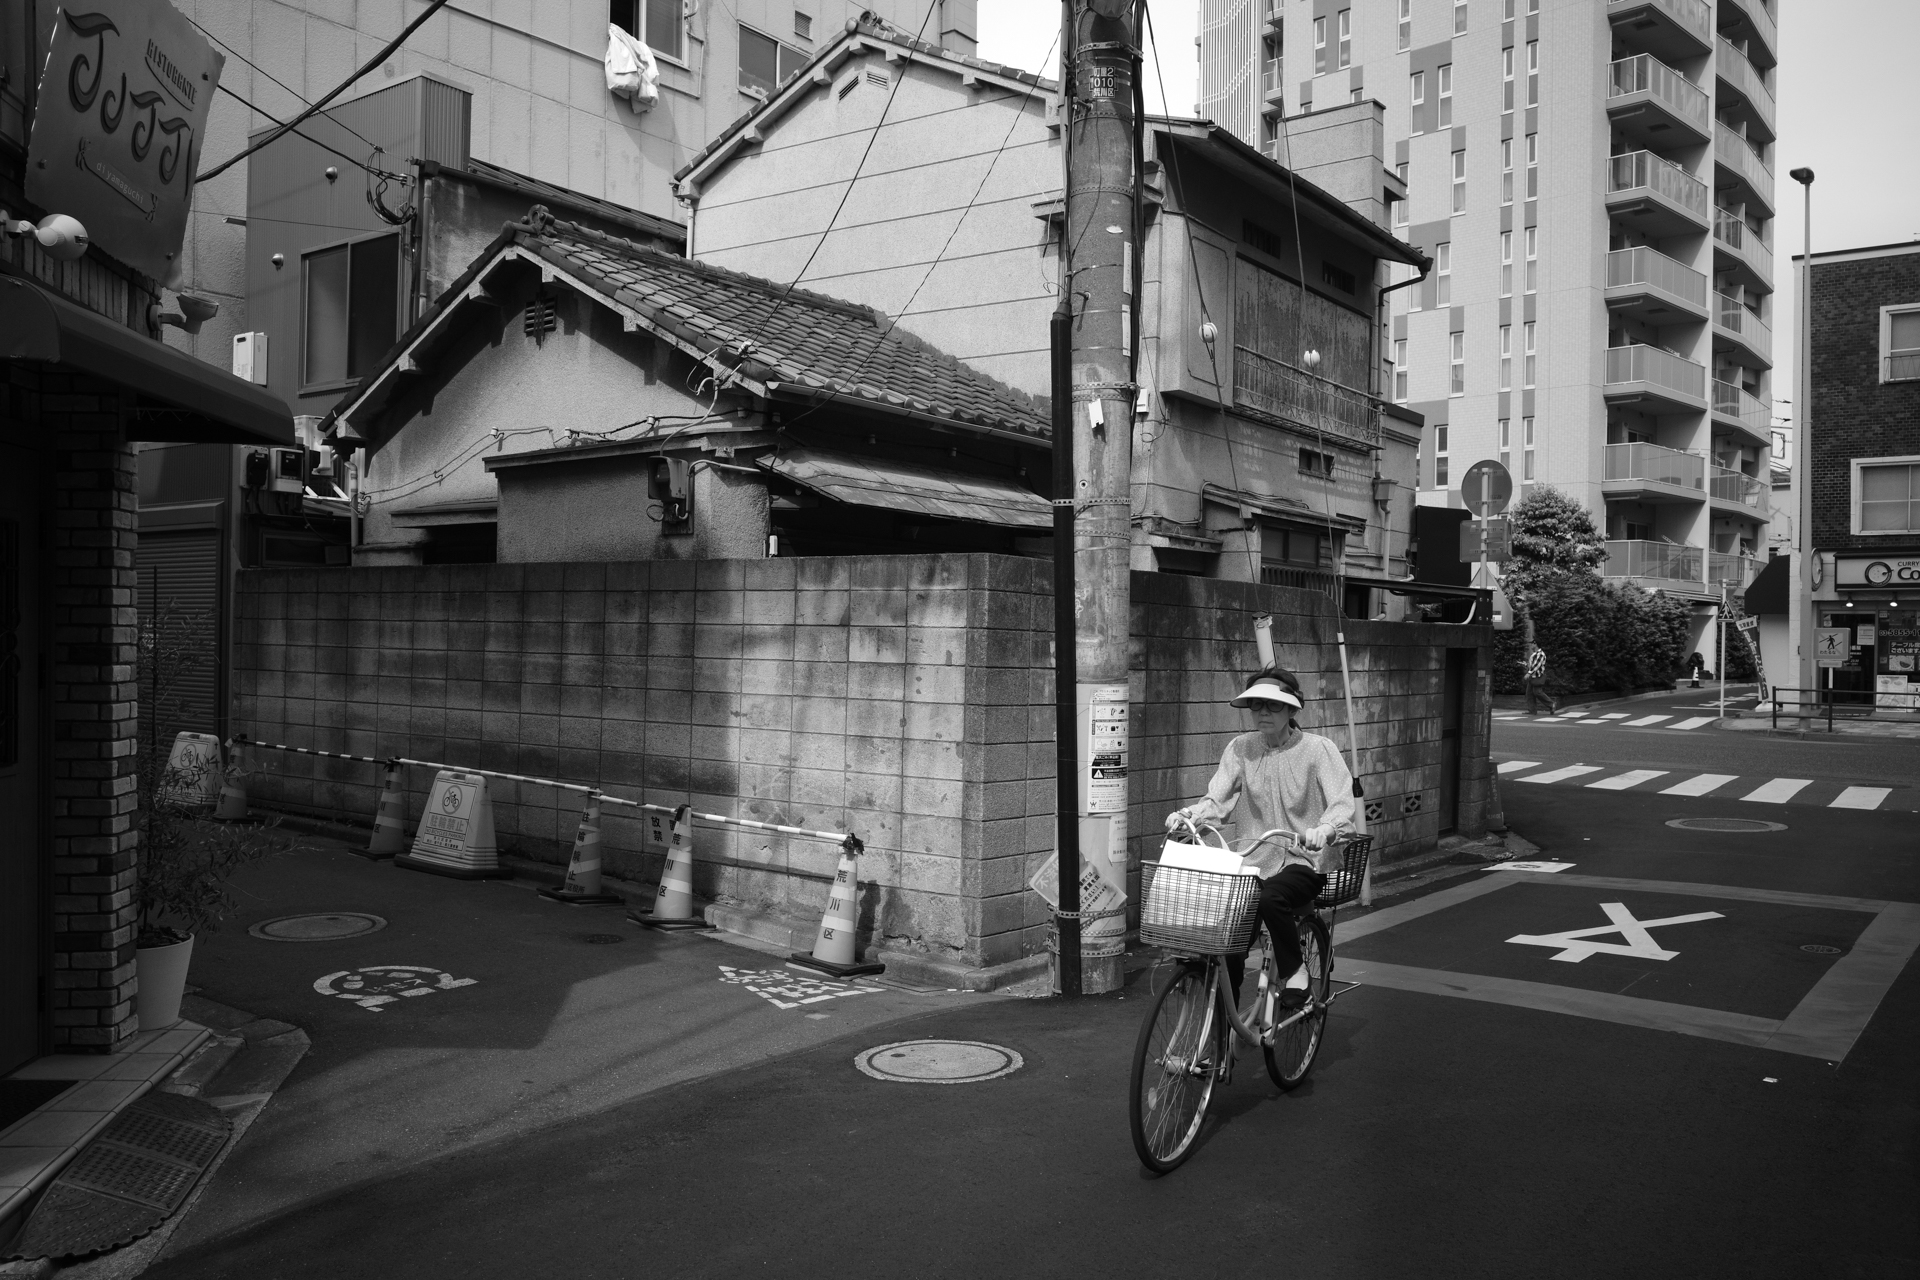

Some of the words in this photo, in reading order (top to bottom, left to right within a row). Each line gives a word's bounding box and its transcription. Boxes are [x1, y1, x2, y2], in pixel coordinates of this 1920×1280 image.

[146, 38, 198, 105] RISTORANTE
[1094, 78, 1114, 88] 010
[96, 162, 106, 174] di
[106, 170, 144, 204] yamaguchi
[430, 815, 464, 832] 駐輪禁止
[659, 833, 682, 897] 荒川区
[824, 870, 848, 940] 荒川区
